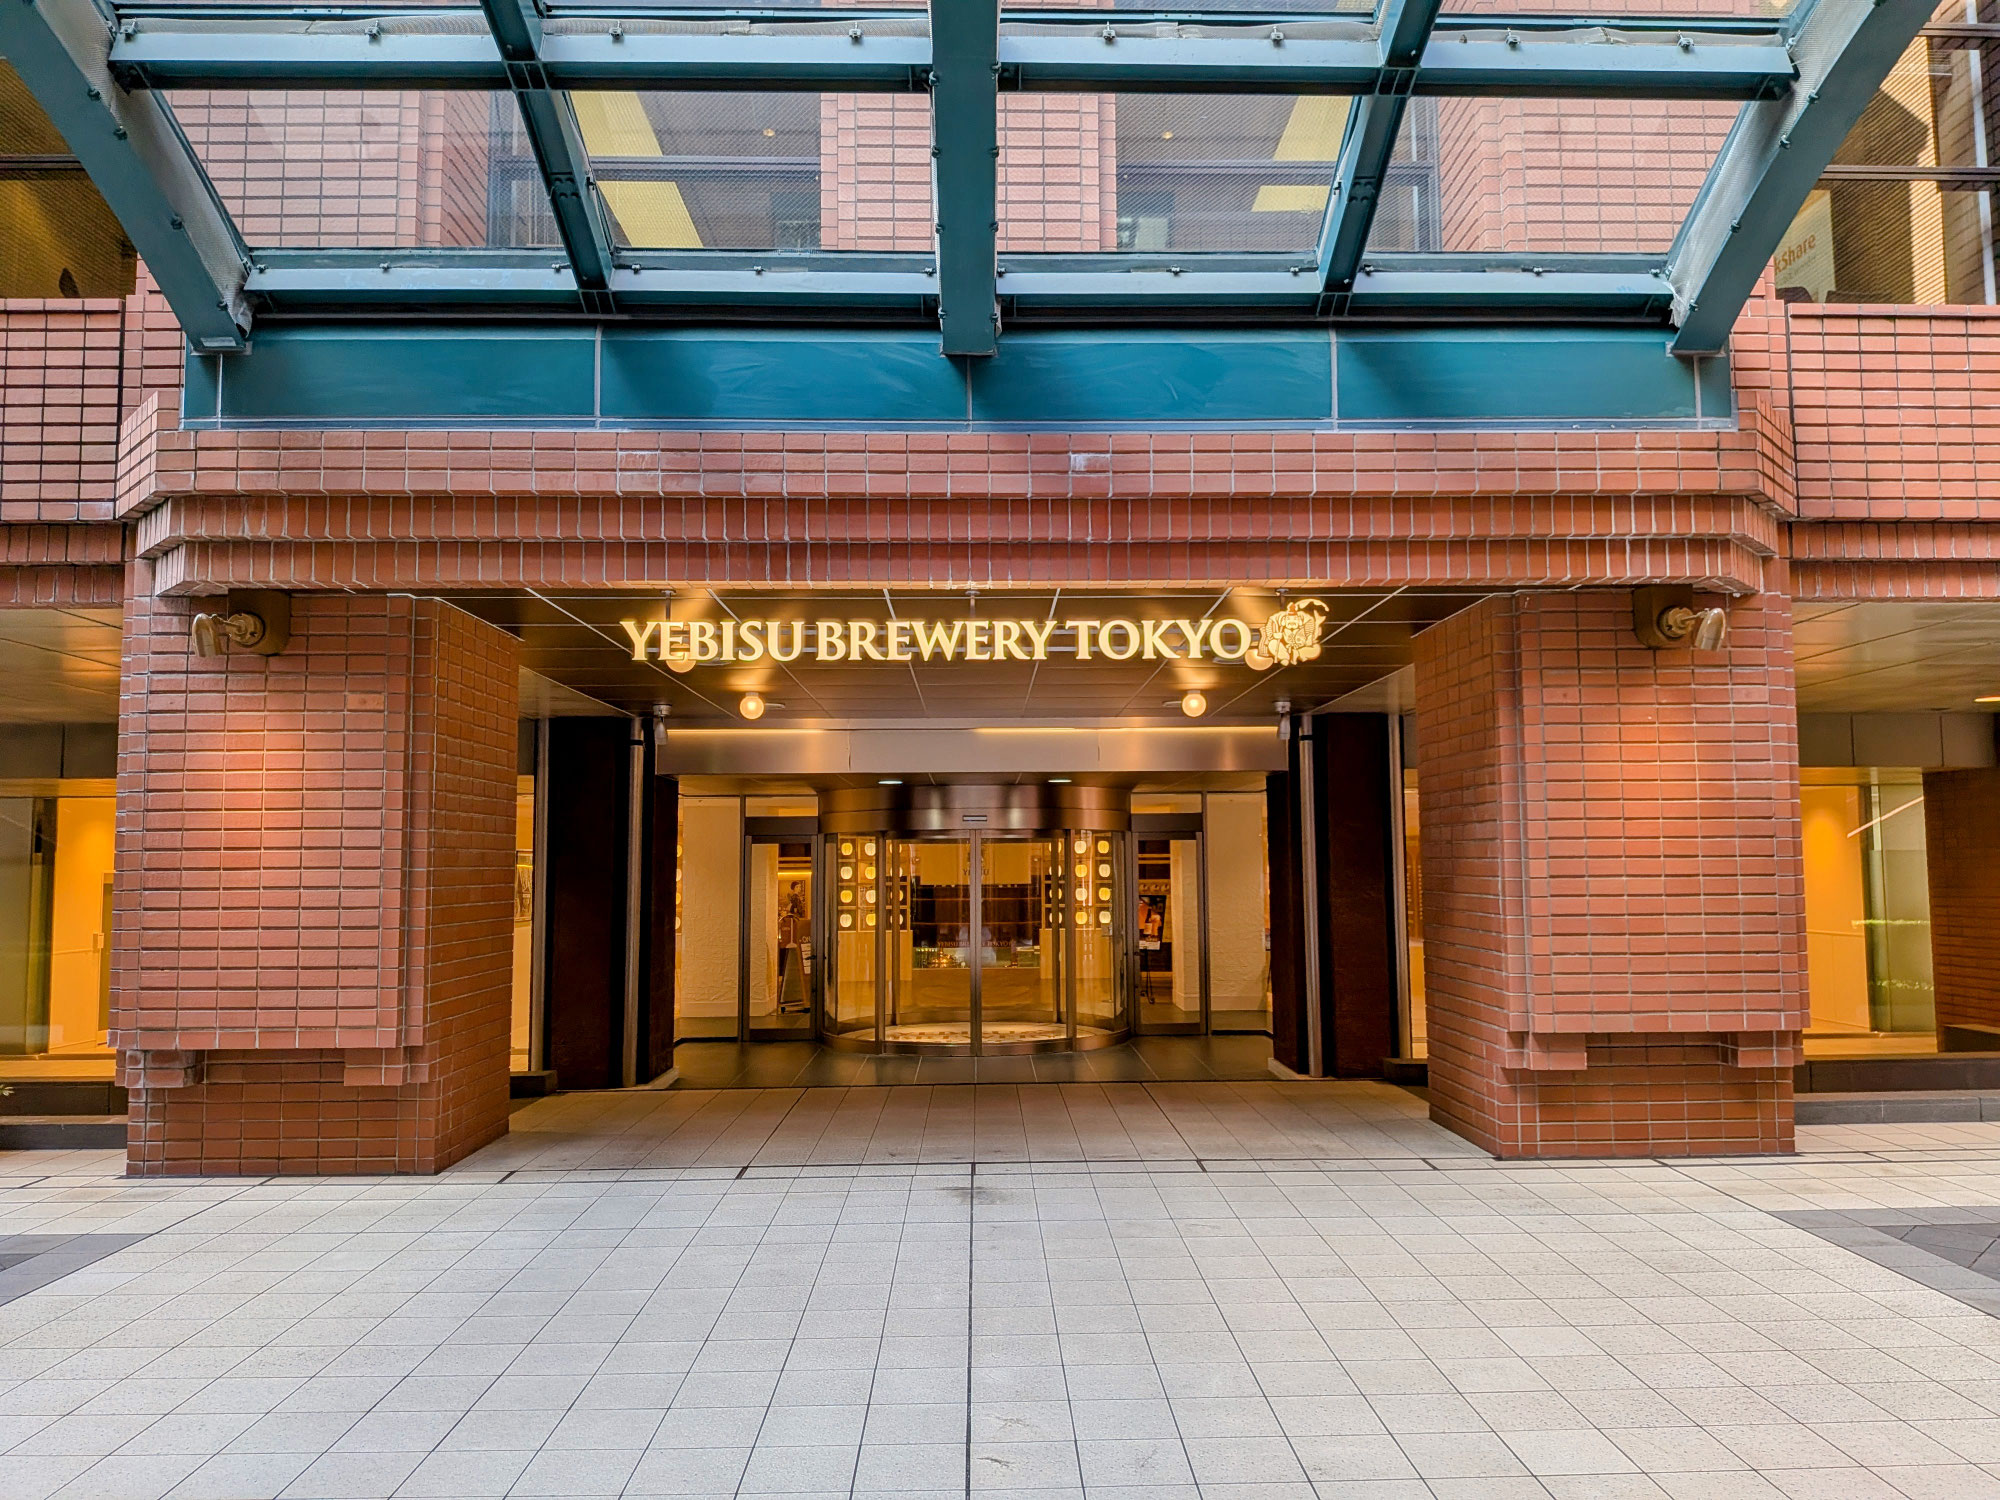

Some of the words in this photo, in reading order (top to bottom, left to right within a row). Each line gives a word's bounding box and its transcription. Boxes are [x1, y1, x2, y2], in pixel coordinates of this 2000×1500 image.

[619, 620, 805, 662] YEBISU
[815, 620, 1058, 662] BREWERY
[1065, 618, 1252, 661] TOKYO
